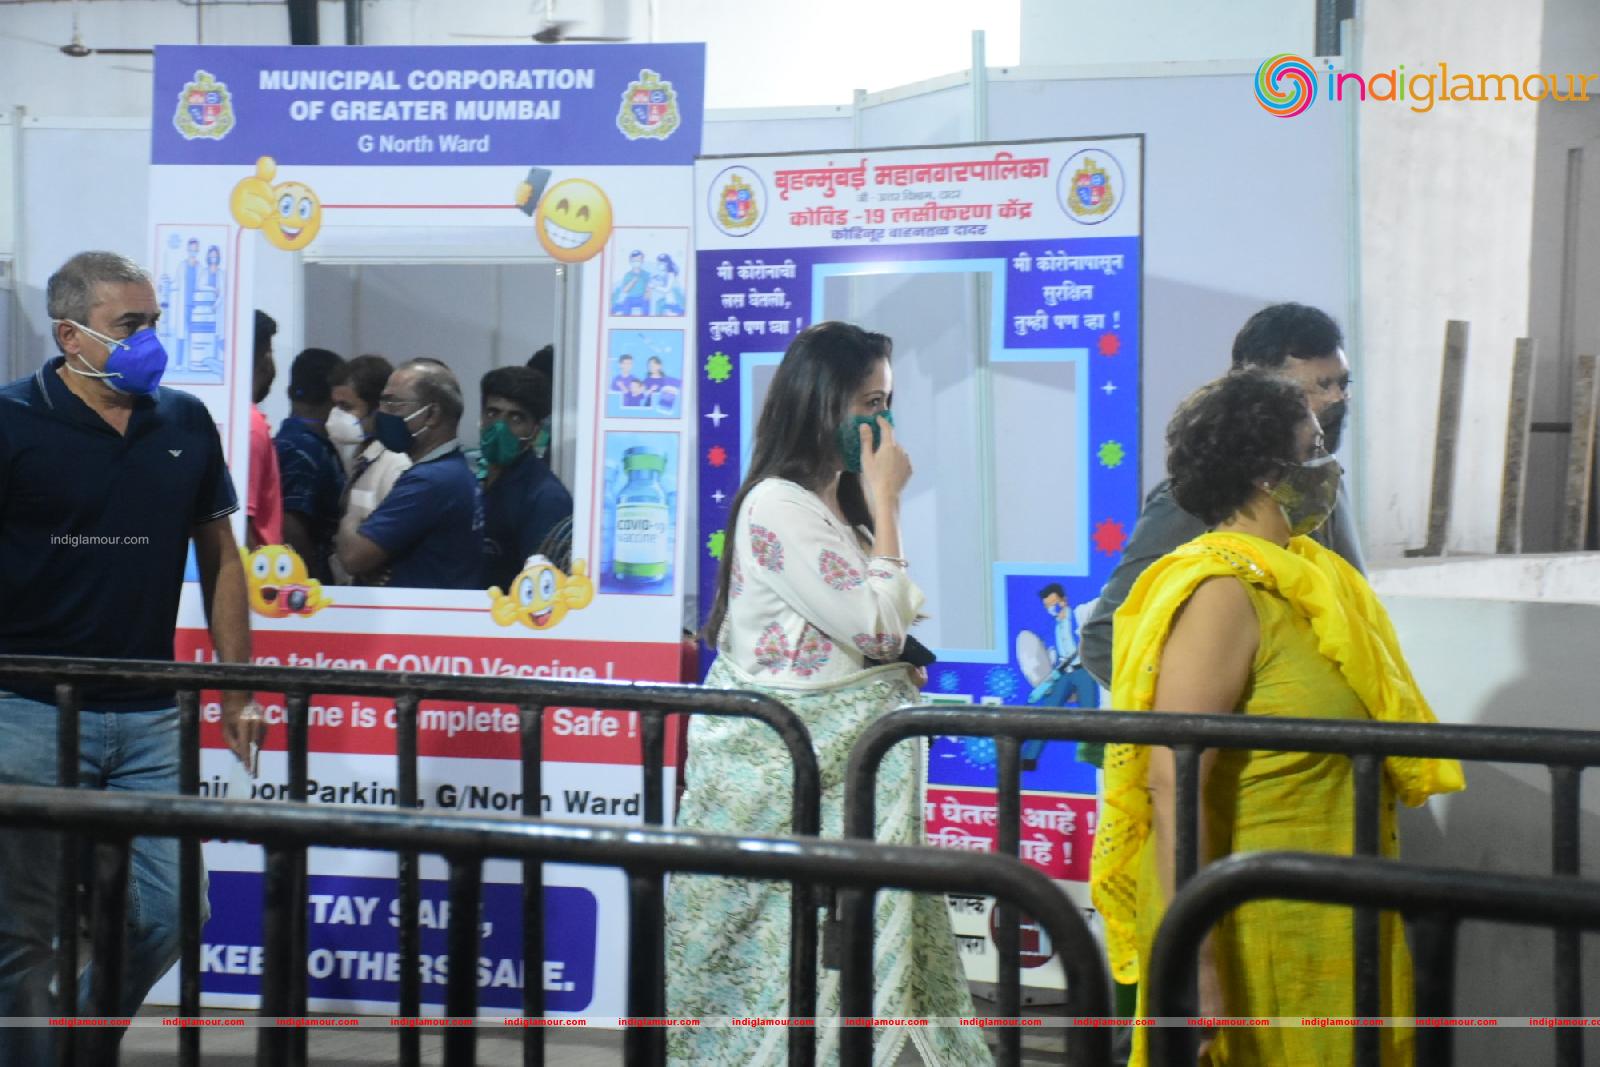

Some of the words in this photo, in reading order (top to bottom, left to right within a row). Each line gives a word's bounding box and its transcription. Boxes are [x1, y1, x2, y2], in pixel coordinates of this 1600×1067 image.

[259, 70, 400, 91] MUNICIPAL
[408, 68, 594, 90] CORPORATION
[290, 100, 324, 121] OF
[330, 100, 448, 121] GREATER
[456, 100, 560, 120] MUMBAI
[358, 136, 374, 152] G
[379, 135, 433, 152] North
[439, 134, 490, 152] Ward
[874, 151, 1050, 186] महानगरपालिका
[789, 206, 848, 227] कोविड
[891, 201, 993, 222] लसीकरण
[716, 260, 734, 280] मी
[1012, 251, 1032, 272] मी
[1036, 250, 1125, 276] कोरोनापासून
[1052, 314, 1080, 330] पण
[376, 654, 472, 676] COVID
[352, 702, 377, 728] is
[384, 706, 520, 737] cmplete
[552, 708, 619, 736] Safe
[628, 710, 638, 737] !
[564, 790, 641, 816] Ward
[1021, 802, 1077, 836] आहे
[308, 894, 380, 926] TAY
[199, 944, 264, 976] KEE
